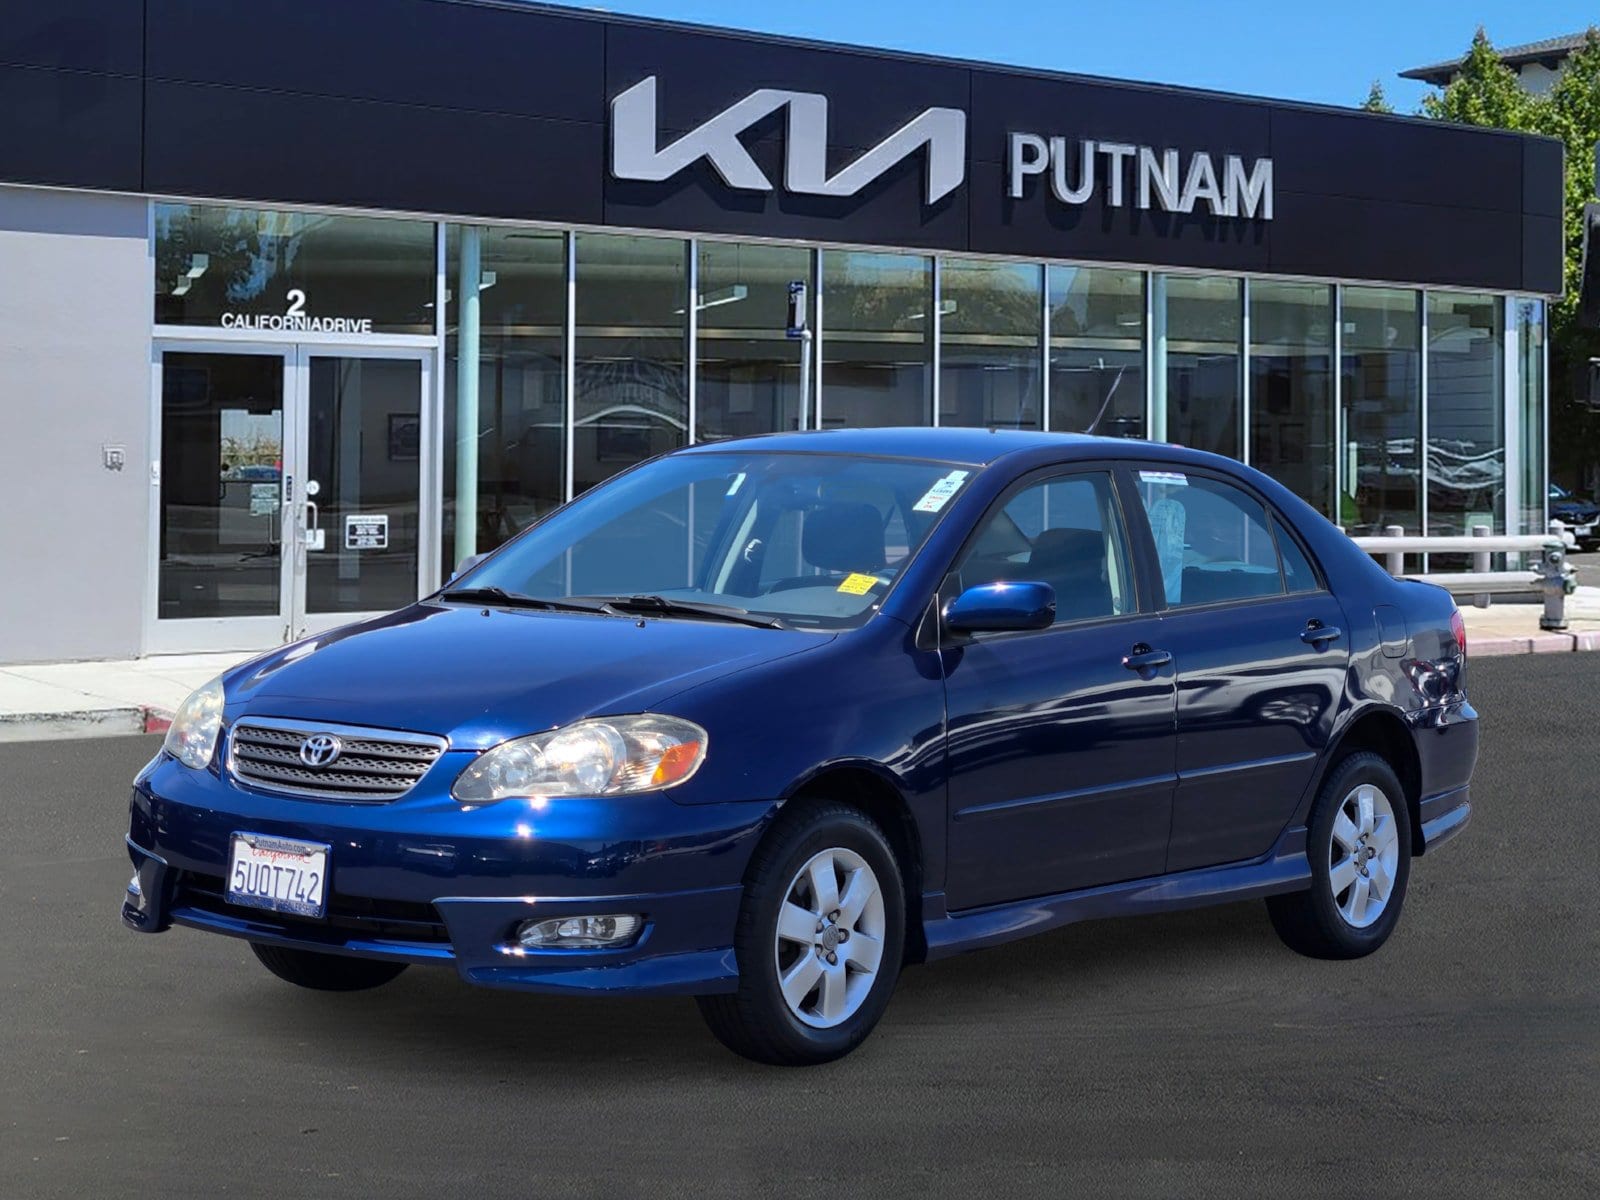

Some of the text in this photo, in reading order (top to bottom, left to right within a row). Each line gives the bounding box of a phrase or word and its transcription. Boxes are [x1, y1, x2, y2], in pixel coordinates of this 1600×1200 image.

[611, 75, 966, 205] KIA
[1008, 132, 1274, 220] PUTNAM
[286, 289, 306, 317] 2
